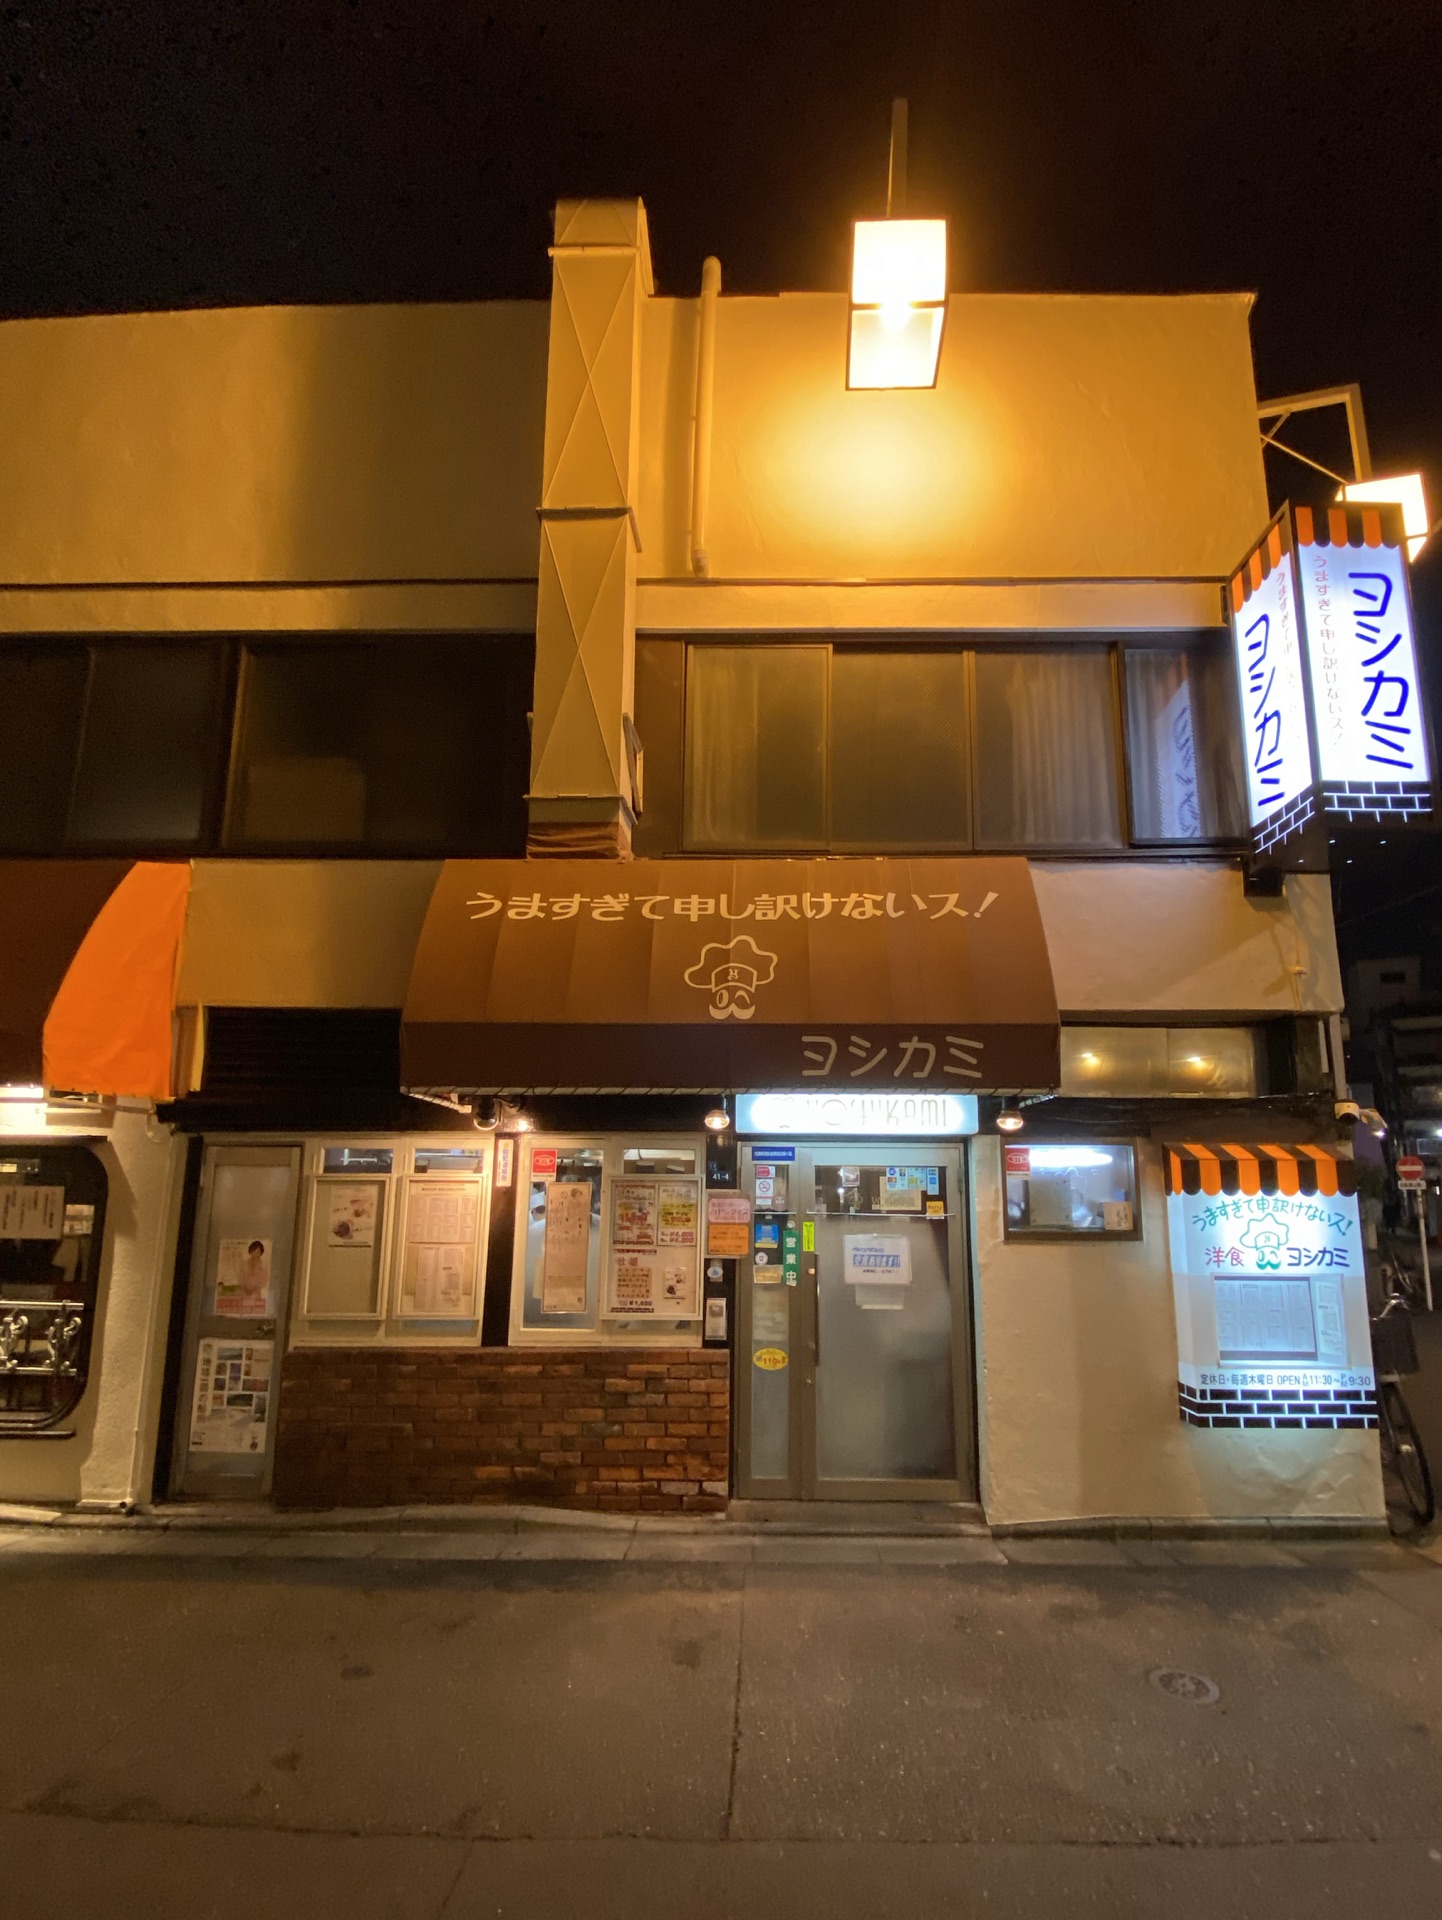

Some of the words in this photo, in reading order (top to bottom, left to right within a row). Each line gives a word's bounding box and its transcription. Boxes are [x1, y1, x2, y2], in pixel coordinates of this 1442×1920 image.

[1348, 572, 1414, 769] ヨシカミ
[1244, 613, 1286, 806] ヨシカミ
[466, 891, 999, 922] うますぎて申し訳けないス!
[801, 1035, 985, 1078] ヨシカミ
[1205, 1246, 1245, 1268] 洋食
[1286, 1247, 1350, 1268] ヨシカミ
[1276, 1375, 1301, 1386] OPEN
